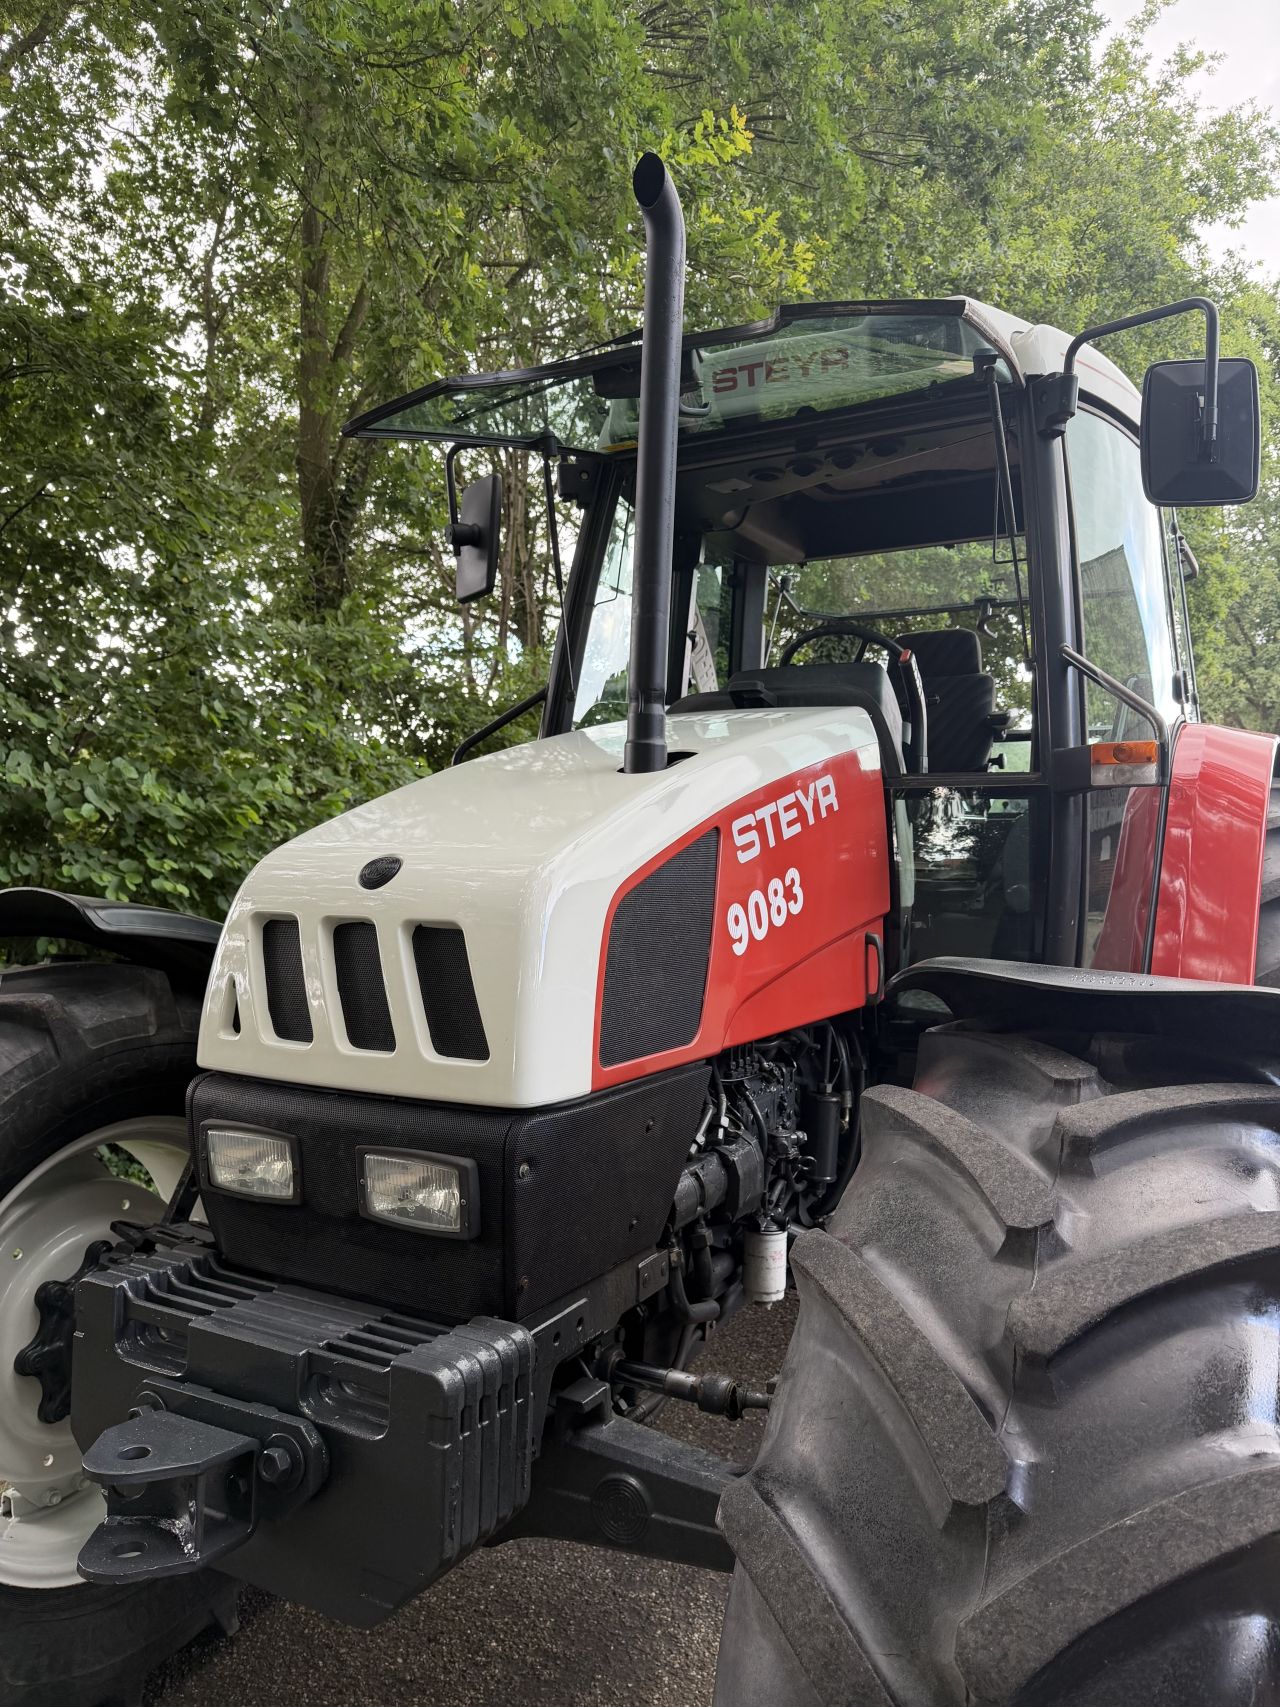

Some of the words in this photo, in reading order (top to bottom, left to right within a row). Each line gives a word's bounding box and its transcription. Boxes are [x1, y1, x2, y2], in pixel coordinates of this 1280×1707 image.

[712, 347, 849, 393] STEYR
[732, 774, 839, 864] STEYR
[727, 868, 803, 956] 9083
